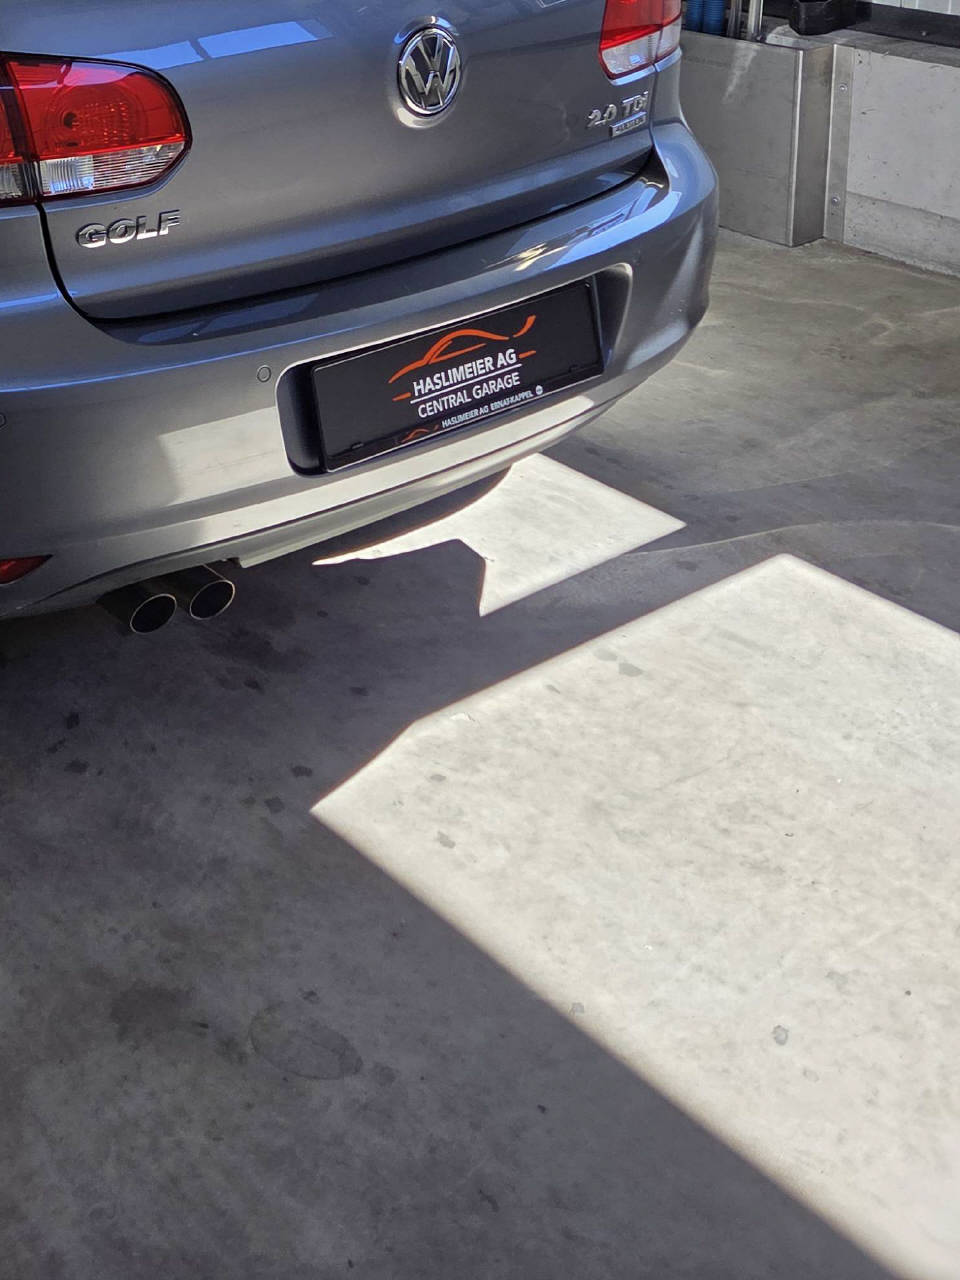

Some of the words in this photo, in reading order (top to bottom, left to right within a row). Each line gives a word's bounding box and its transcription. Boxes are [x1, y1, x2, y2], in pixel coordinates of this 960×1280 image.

[76, 209, 180, 248] GOLF
[413, 357, 494, 396] HASLIMEIER
[497, 349, 517, 368] AG
[418, 389, 471, 418] CENTRAL
[472, 372, 520, 399] GARAGE
[442, 408, 479, 428] HASLIMEIER
[479, 405, 489, 416] AG
